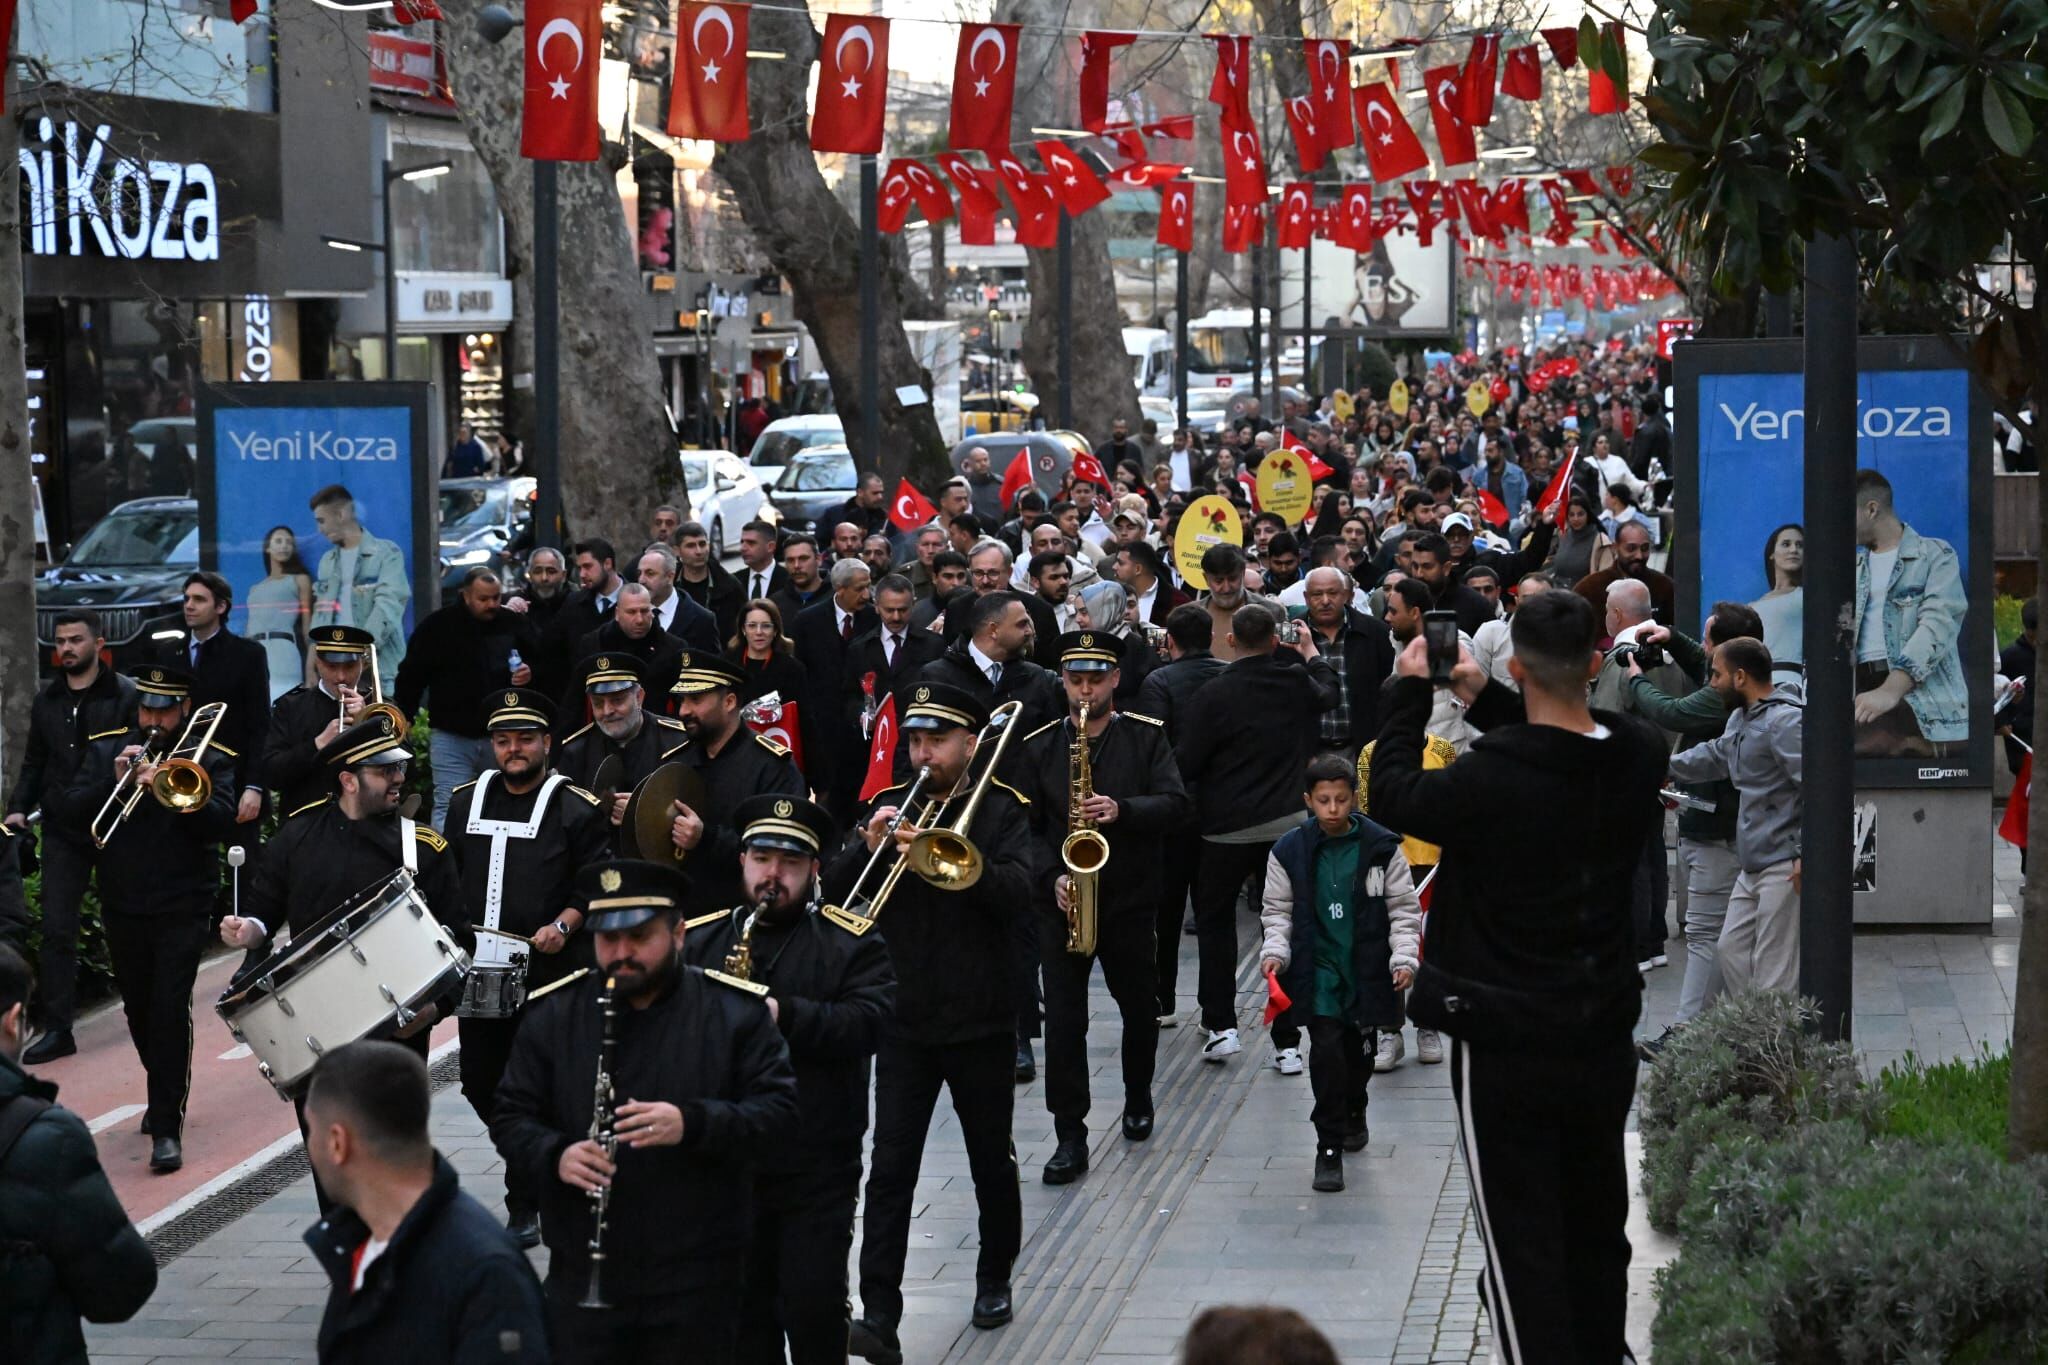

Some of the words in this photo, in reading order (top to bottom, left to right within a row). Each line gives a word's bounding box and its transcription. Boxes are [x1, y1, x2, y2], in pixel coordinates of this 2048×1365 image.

[65, 121, 219, 261] Koza
[240, 294, 272, 382] oza
[1719, 402, 1804, 441] Yen
[1857, 400, 1950, 437] oza
[228, 431, 301, 461] Yeni
[309, 431, 397, 461] Koza
[1328, 902, 1344, 919] 18
